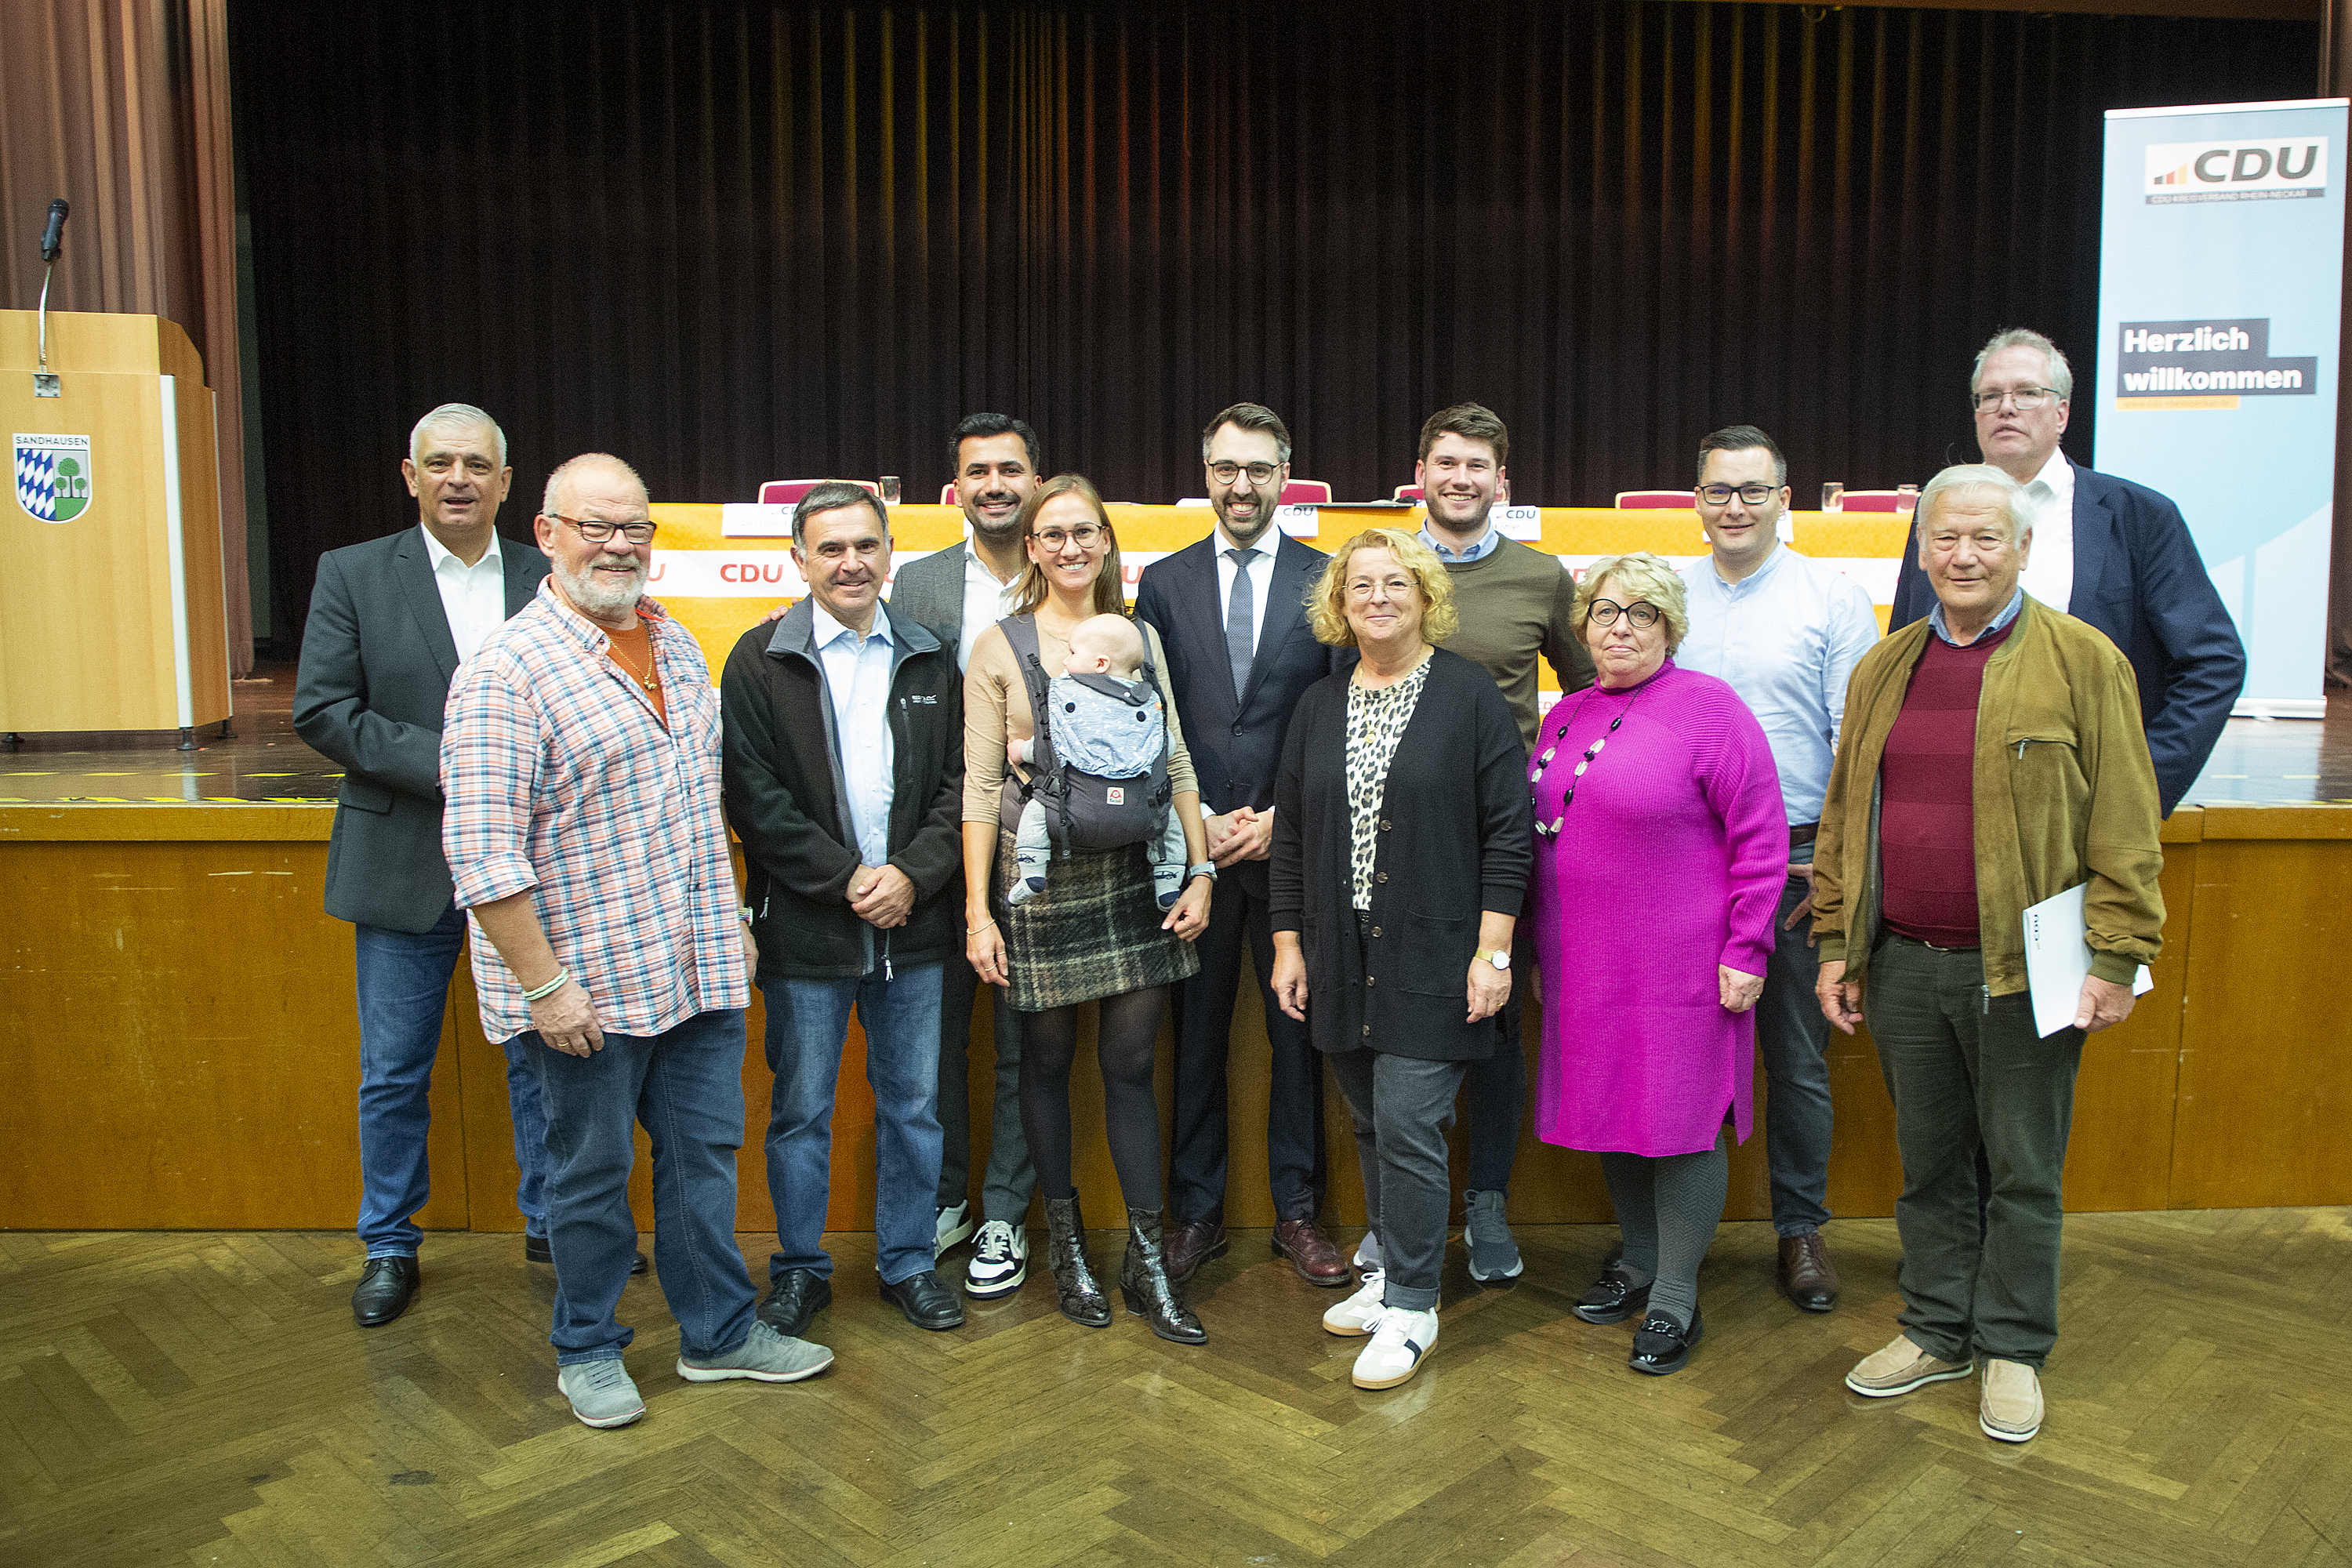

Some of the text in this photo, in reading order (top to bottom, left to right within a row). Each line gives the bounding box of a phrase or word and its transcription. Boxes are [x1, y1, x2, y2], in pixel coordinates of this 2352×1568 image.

[2194, 145, 2318, 183] CDU
[2124, 325, 2249, 353] Herzlich
[2123, 366, 2303, 391] willkommen
[16, 437, 88, 445] SANDHAUSEN
[1283, 507, 1313, 516] CDU
[1506, 510, 1536, 518] CDU
[720, 563, 784, 583] CDU
